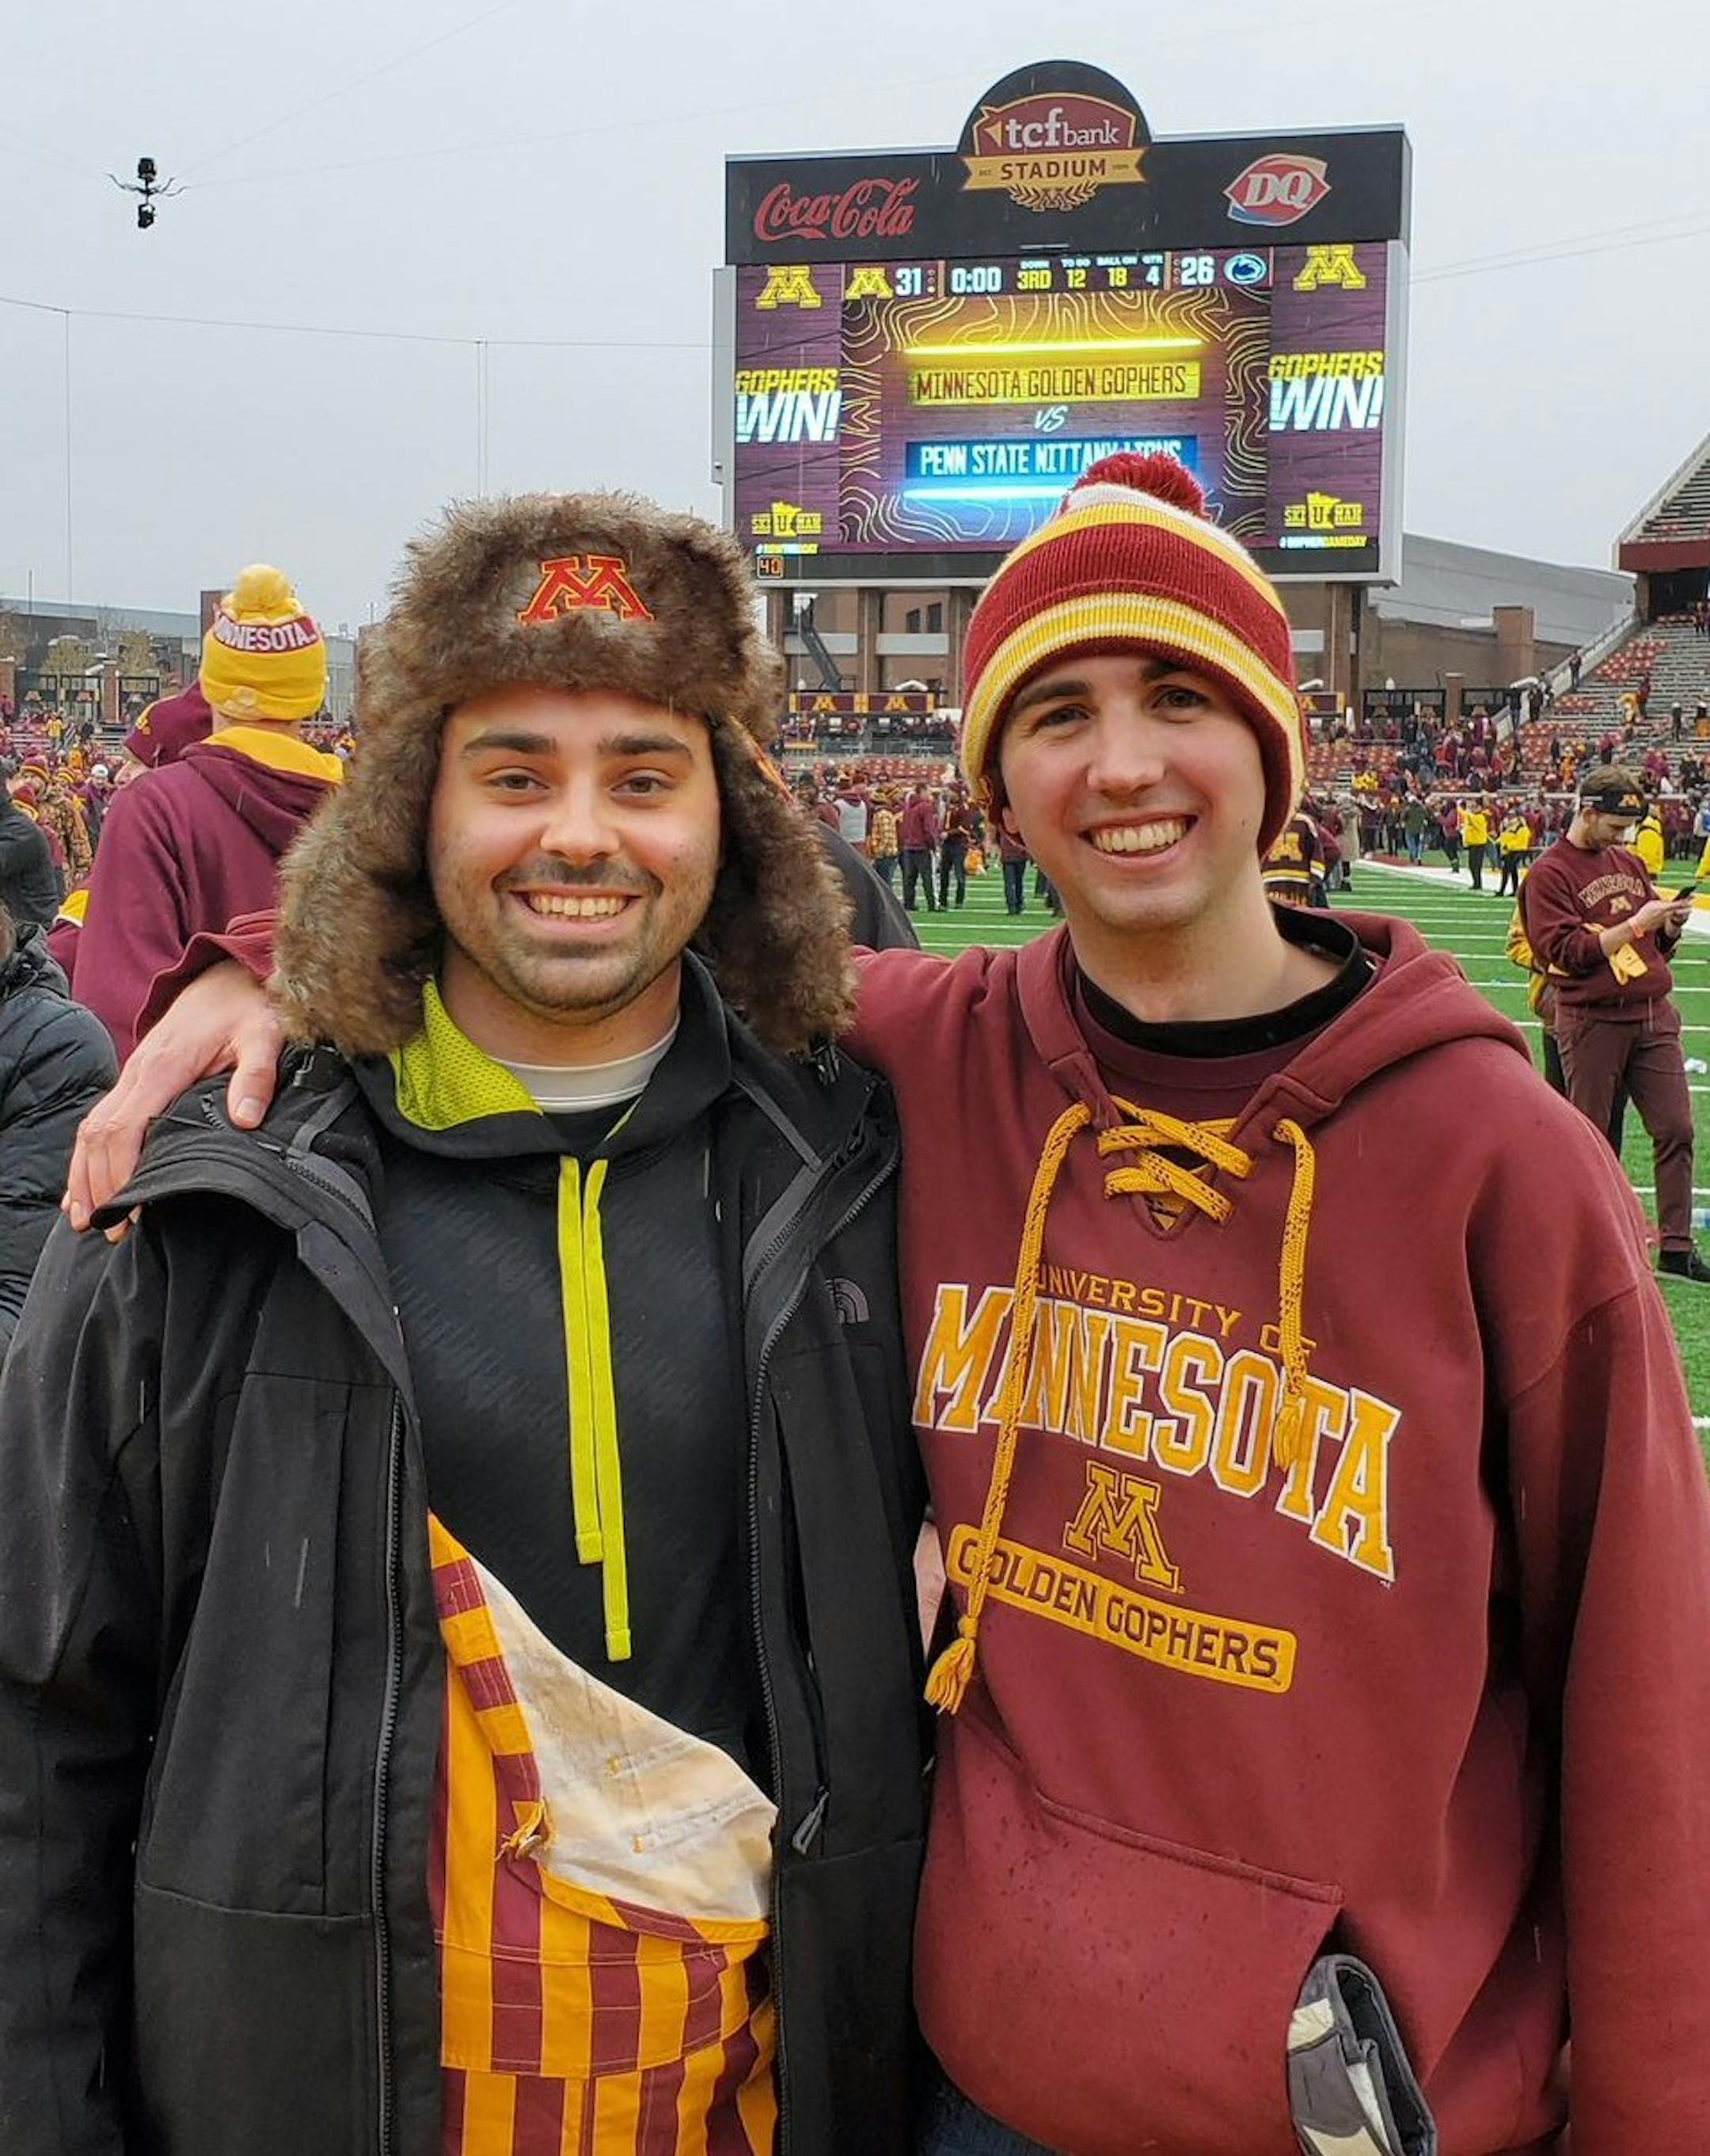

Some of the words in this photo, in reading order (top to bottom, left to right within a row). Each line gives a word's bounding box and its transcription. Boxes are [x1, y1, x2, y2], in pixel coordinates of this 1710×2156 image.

[1001, 159, 1106, 180] STADIUM
[1243, 171, 1313, 209] DQ
[895, 268, 922, 295] 31
[952, 267, 1001, 293] 0:00
[1017, 270, 1053, 290] 3RD
[1066, 268, 1087, 288] 12
[1108, 267, 1128, 287] 18
[1146, 266, 1160, 286] 4
[1180, 256, 1215, 286] 26
[1268, 351, 1385, 380] GOPHERS
[735, 368, 838, 394] GOPHERS
[917, 369, 1021, 400] MINNESOTA
[1029, 368, 1095, 397] GOLDEN
[1101, 365, 1187, 394] GOPHERS
[735, 391, 842, 443] WIN!
[1268, 375, 1384, 431] WIN!
[921, 444, 965, 475] PENN
[972, 443, 1029, 474] STATE
[518, 553, 655, 626] M
[215, 615, 310, 652] NESOTA
[1063, 1460, 1180, 1594] M
[1107, 1594, 1279, 1679] GOPHERS
